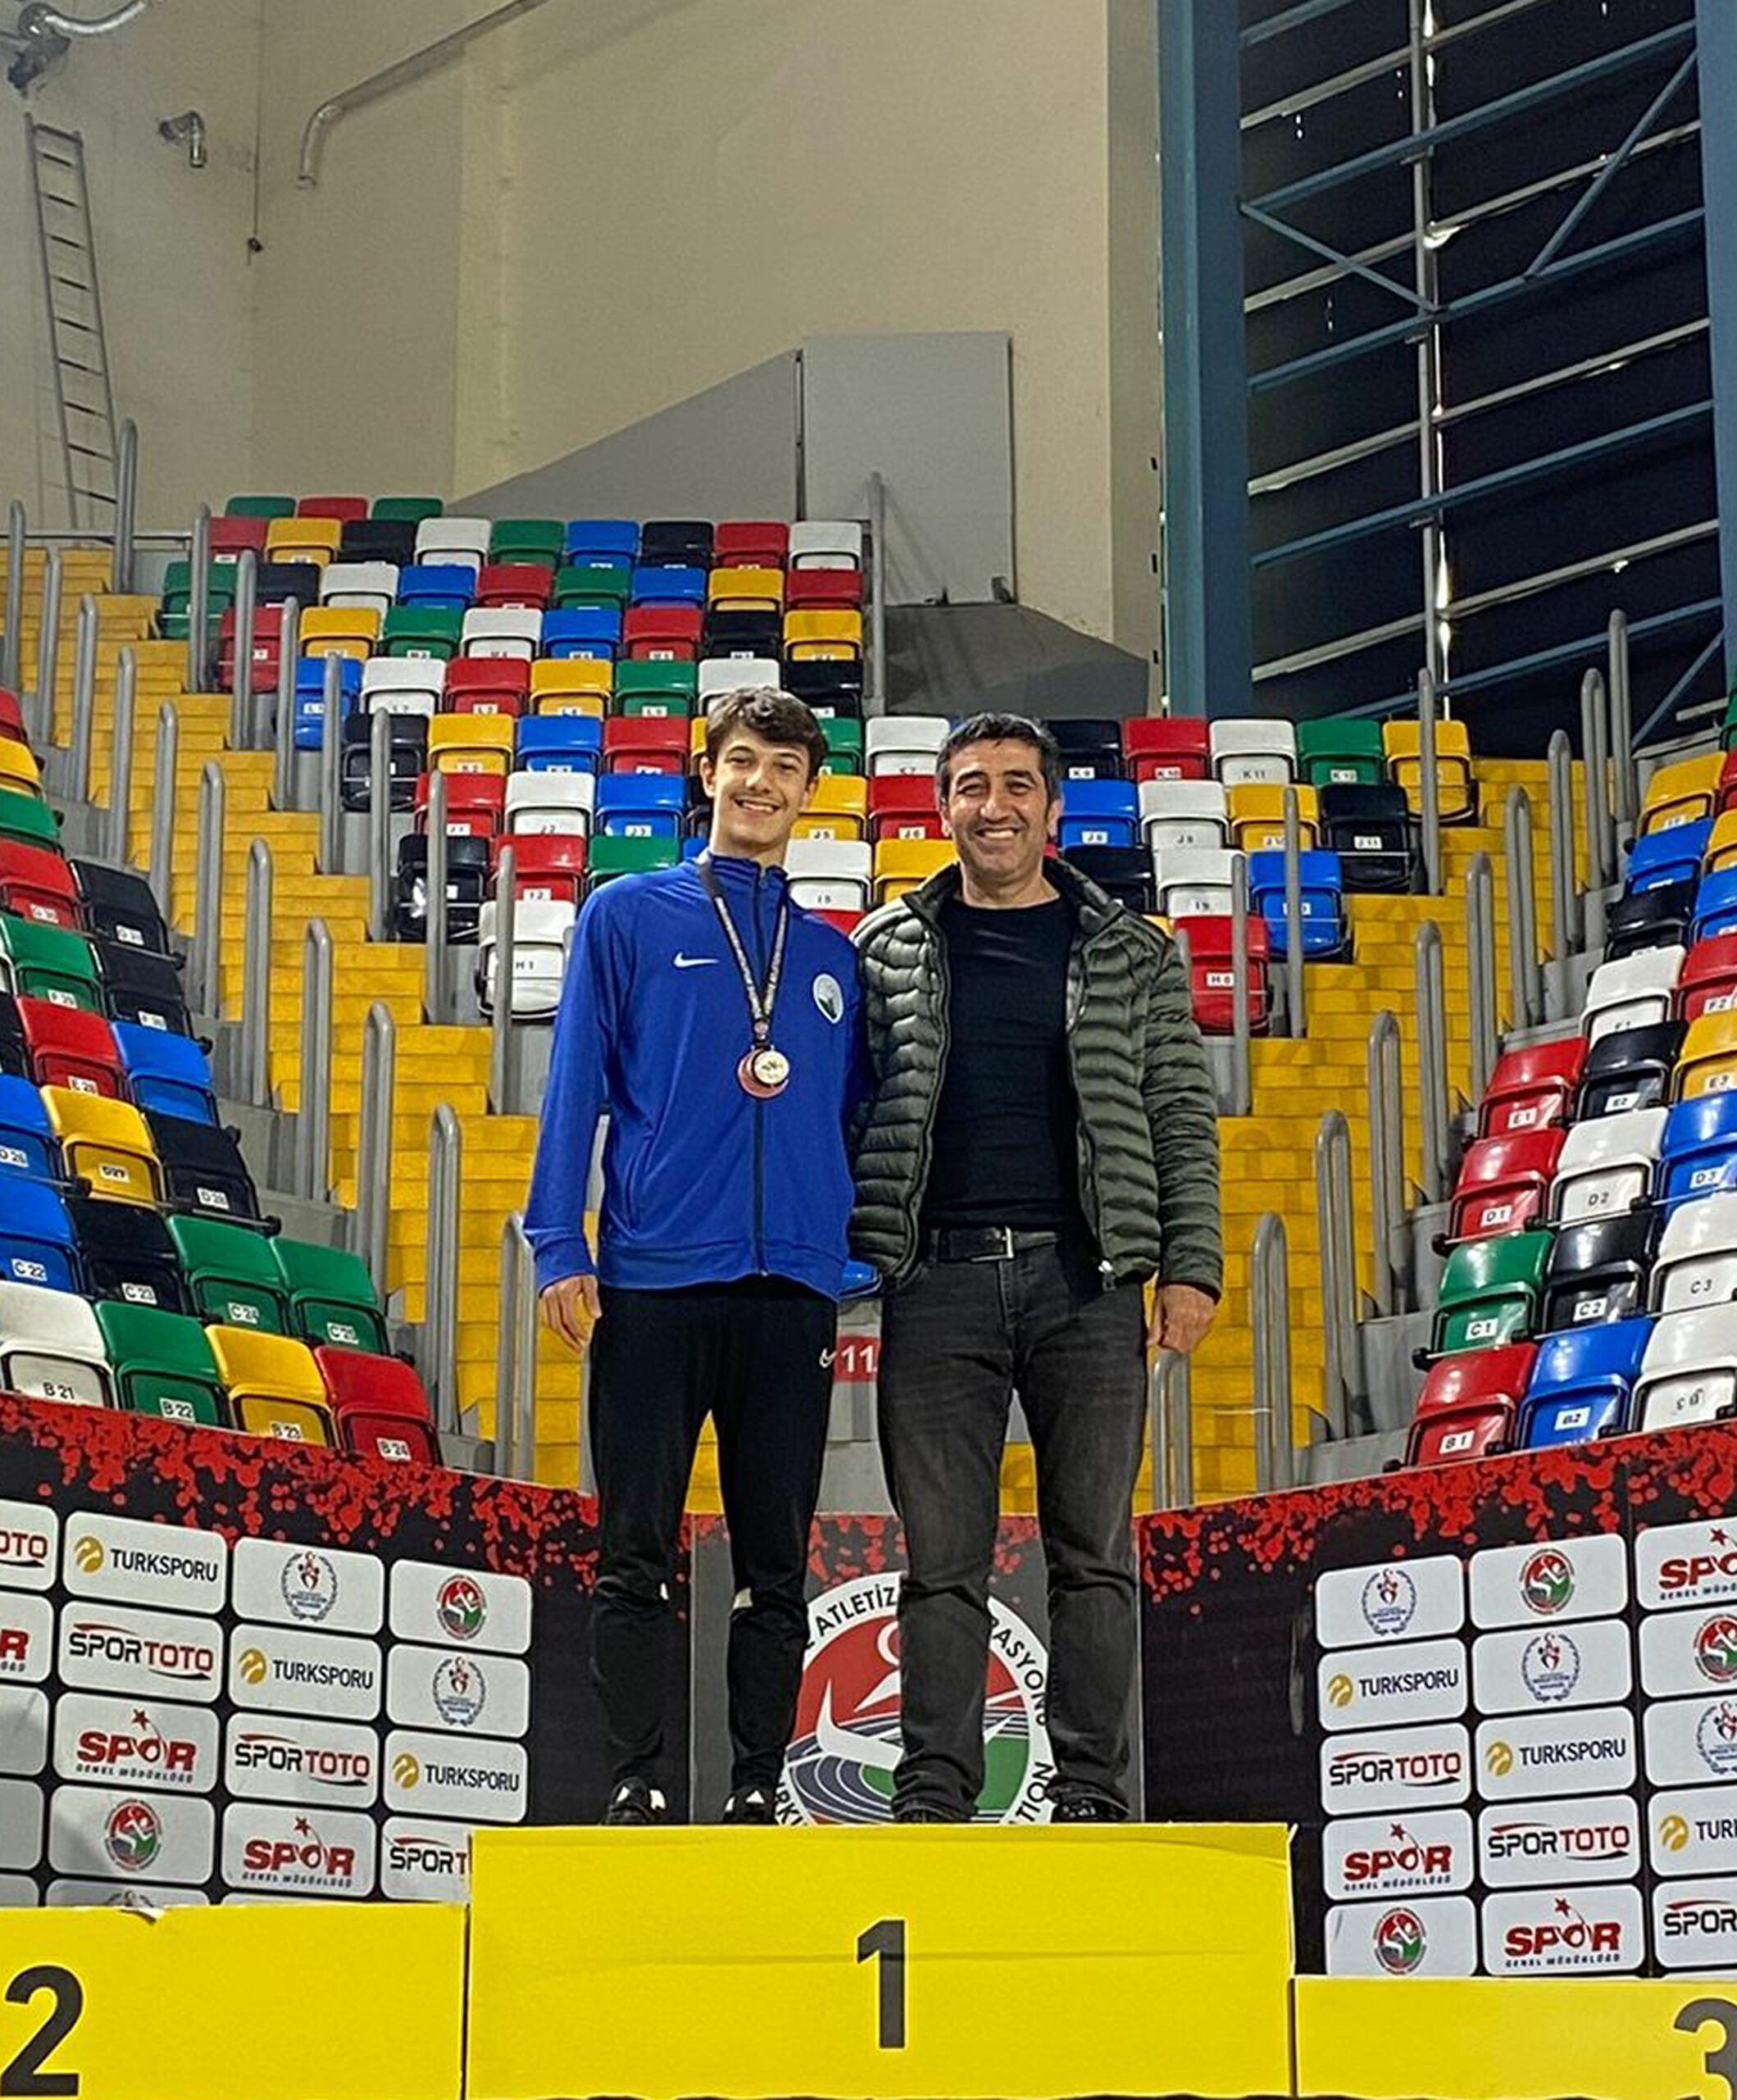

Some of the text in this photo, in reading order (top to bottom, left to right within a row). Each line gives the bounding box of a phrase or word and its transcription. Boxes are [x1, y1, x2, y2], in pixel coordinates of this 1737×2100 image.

[15, 1262, 25, 1274] C
[125, 1285, 134, 1298] C
[1690, 1281, 1701, 1294] C
[233, 1305, 242, 1317] C
[1579, 1303, 1591, 1316] C
[1470, 1322, 1492, 1336] C 1
[43, 1381, 75, 1399] B 21
[163, 1400, 192, 1418] B 22
[271, 1423, 281, 1436] B
[381, 1440, 390, 1454] B
[110, 1548, 218, 1582] TURKSPORU
[272, 1659, 374, 1690] TURKSPORU
[1359, 1669, 1459, 1697] TURKSPORU
[77, 1731, 197, 1772] SPOR
[1519, 1737, 1626, 1766] TURKSPORU
[425, 1764, 520, 1792] TURKSPORU
[1695, 1818, 1737, 1841] TUR
[244, 1839, 355, 1876] SPOR
[1343, 1845, 1452, 1881] SPOR
[1505, 1922, 1621, 1957] SPOR
[857, 1920, 905, 2048] 1
[0, 1965, 83, 2097] 2
[1674, 1997, 1737, 2100] 3
